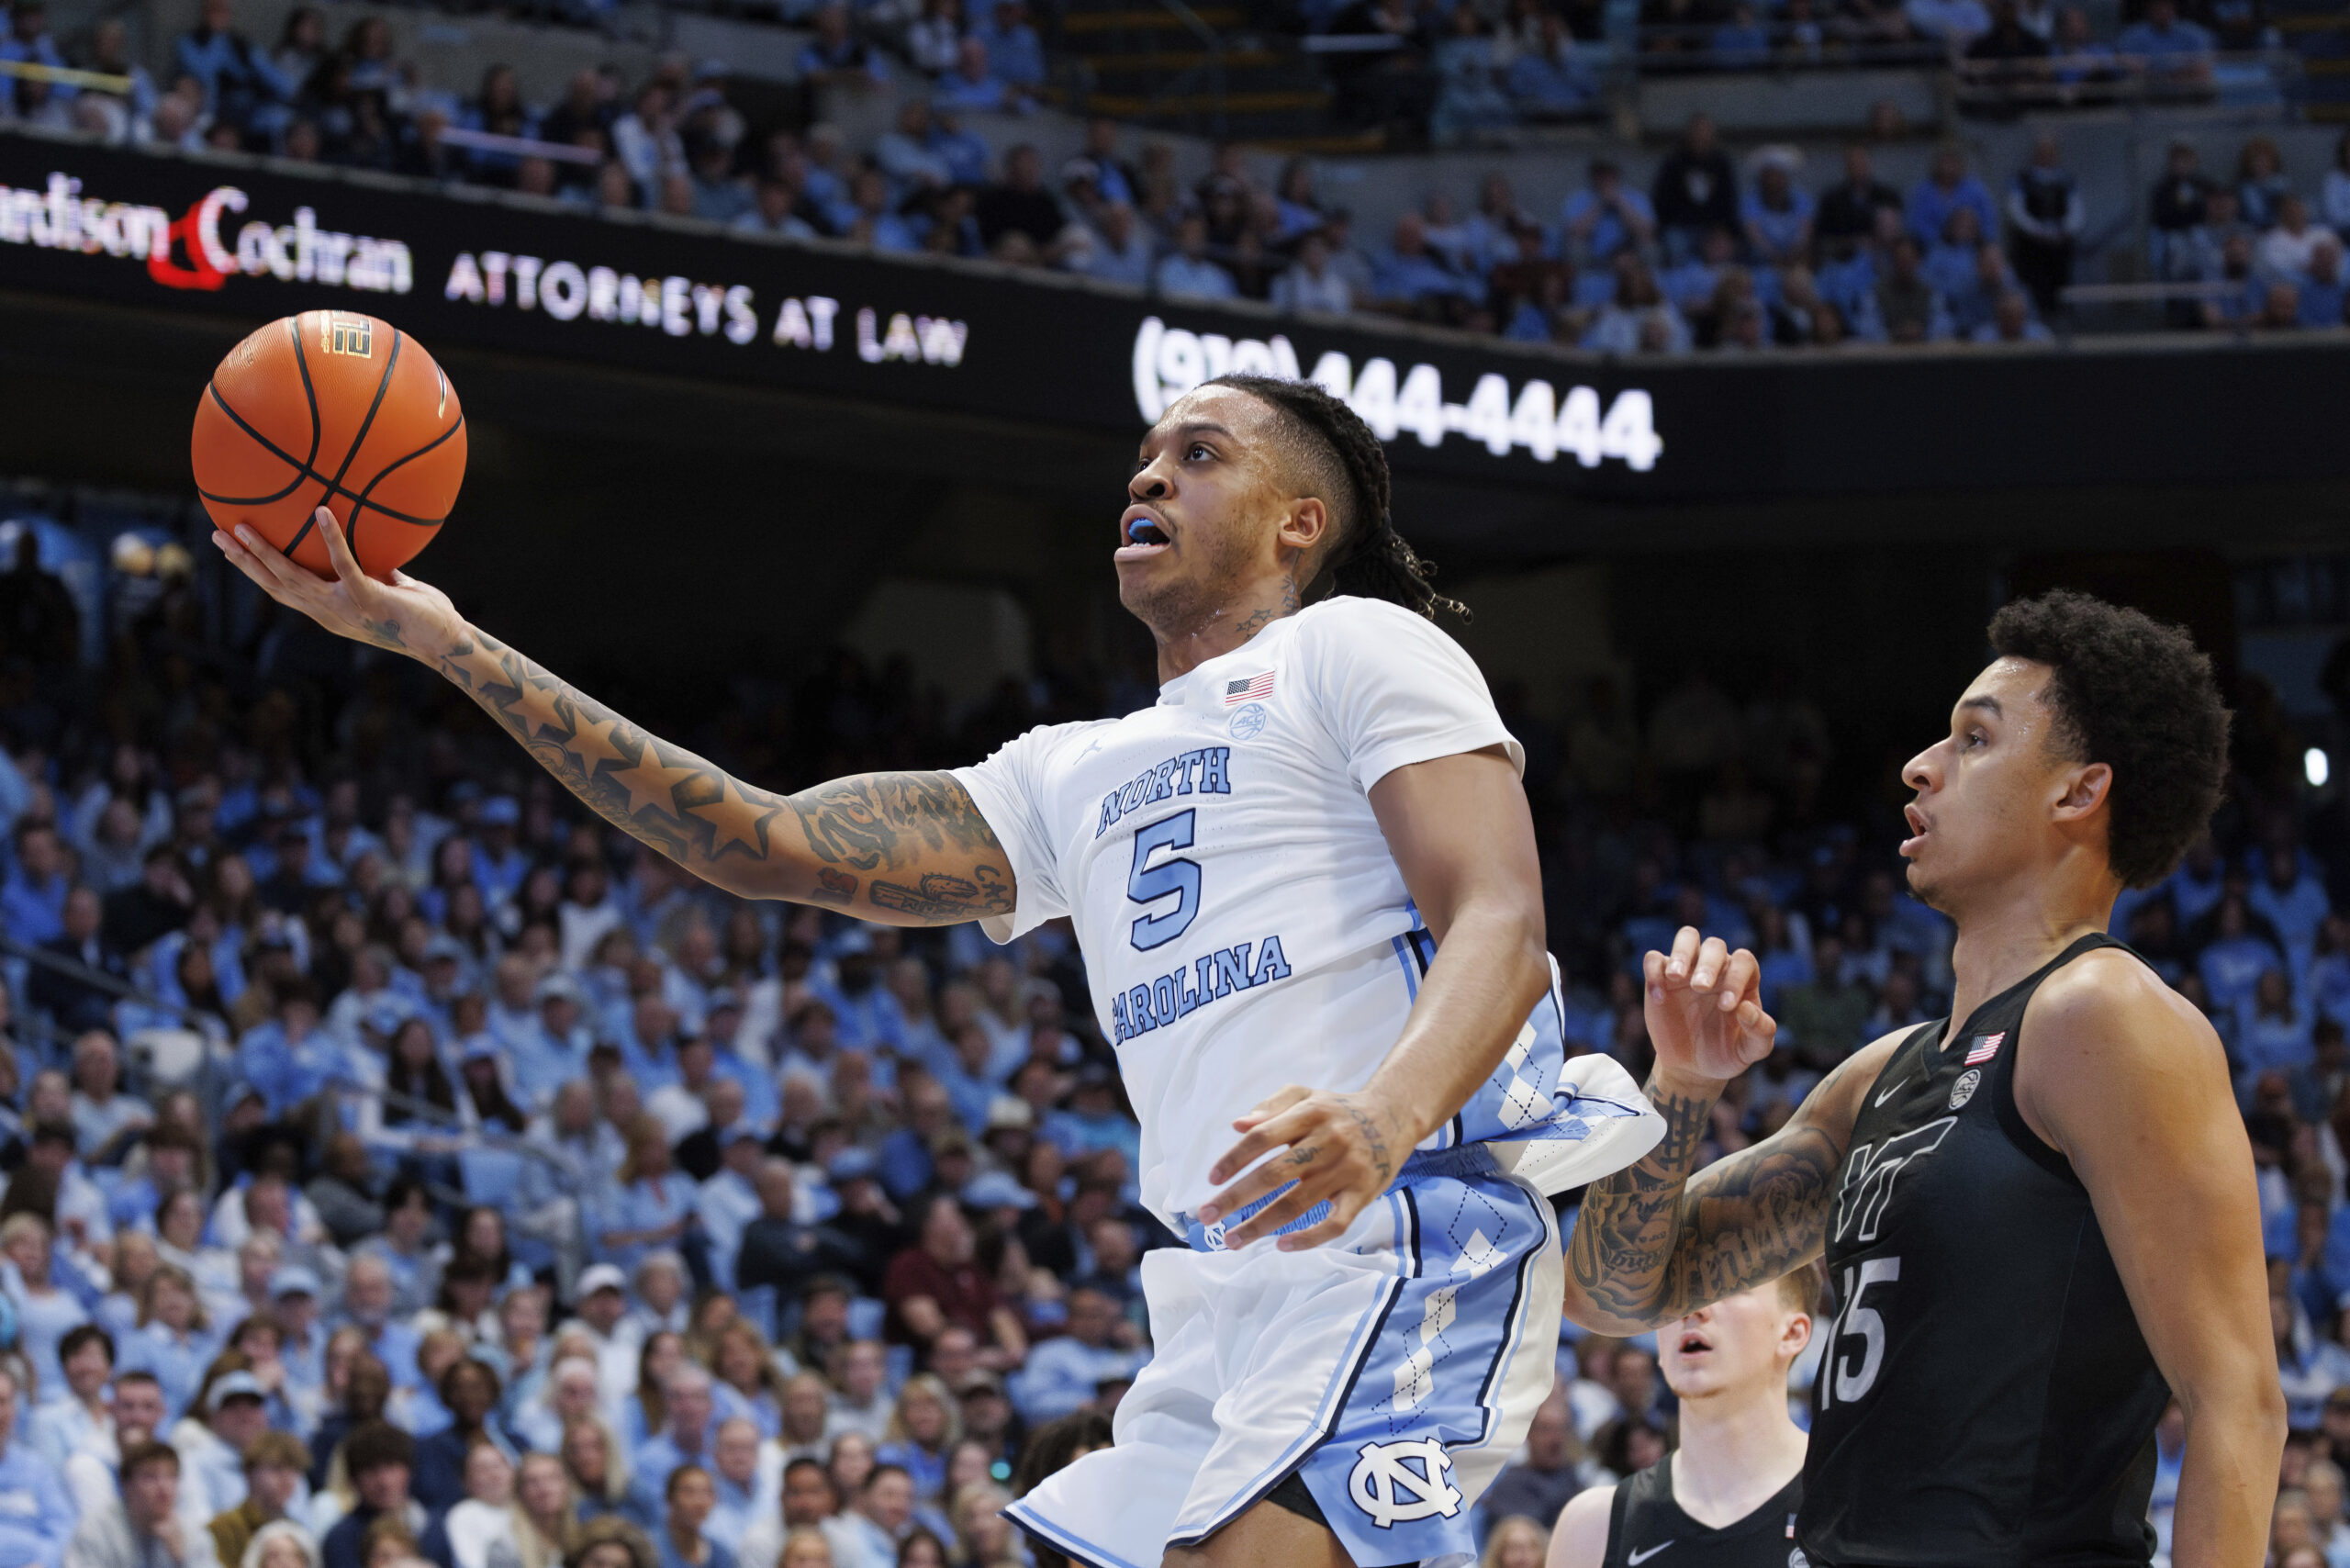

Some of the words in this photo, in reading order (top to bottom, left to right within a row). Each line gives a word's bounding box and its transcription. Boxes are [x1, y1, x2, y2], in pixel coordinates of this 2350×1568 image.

[197, 185, 415, 294] Cochran
[444, 250, 759, 345] ATTORNEYS
[773, 295, 840, 352] AT
[855, 306, 968, 366] LAW
[1095, 746, 1231, 840] NORTH
[1127, 807, 1202, 952] 5
